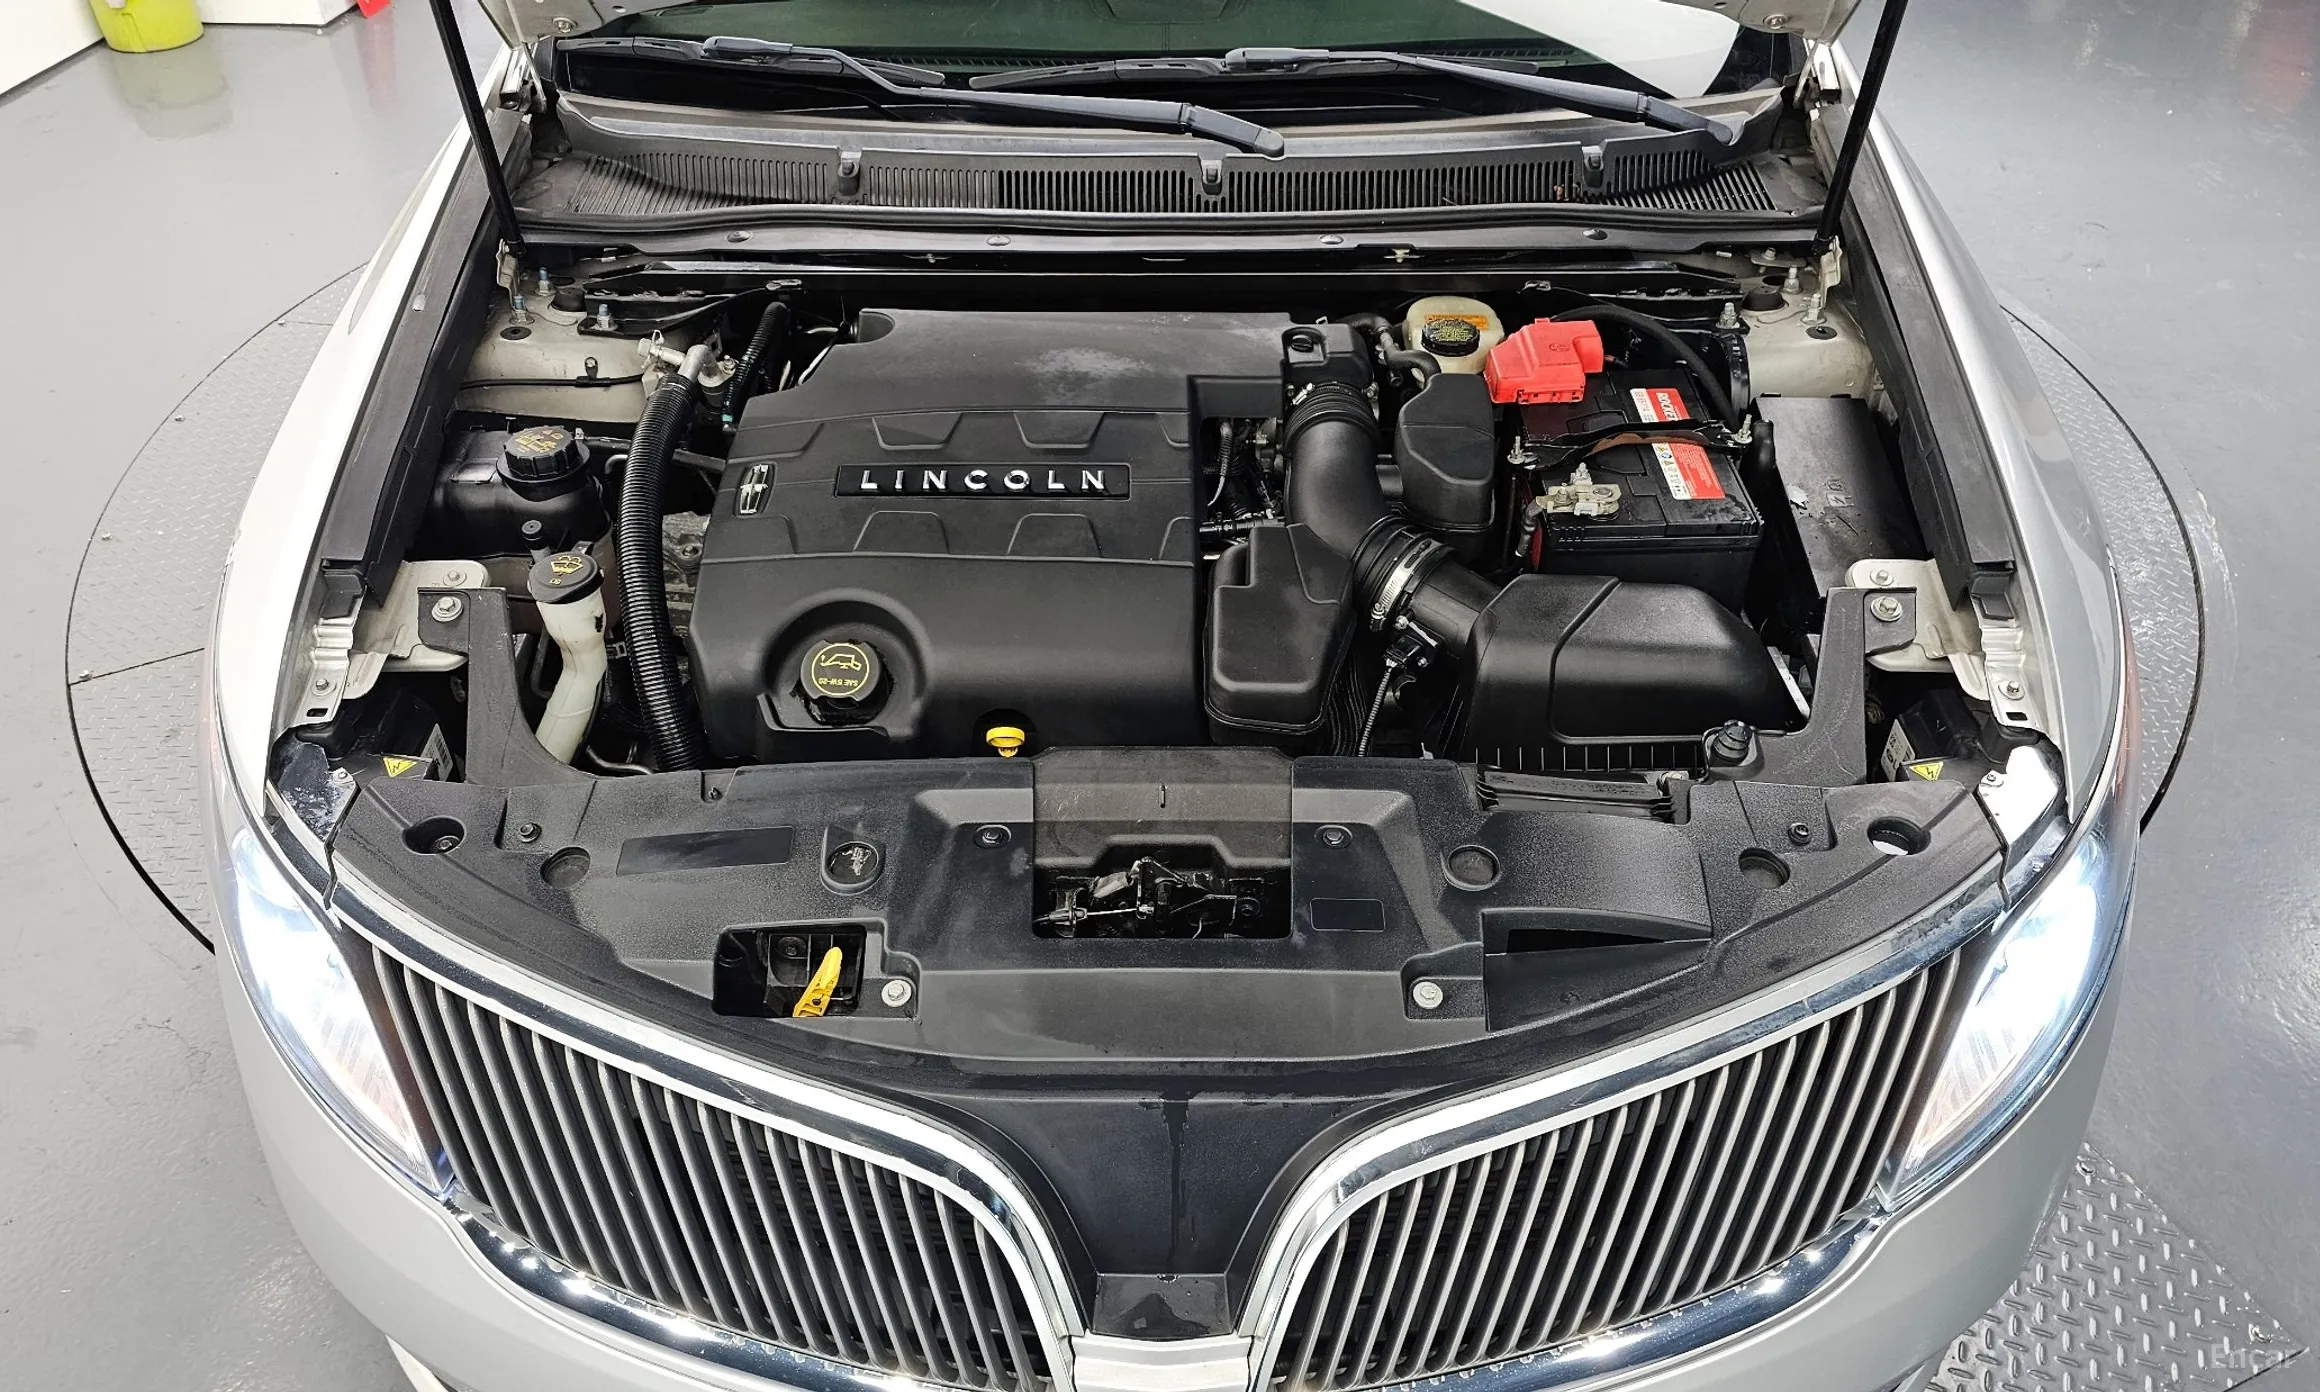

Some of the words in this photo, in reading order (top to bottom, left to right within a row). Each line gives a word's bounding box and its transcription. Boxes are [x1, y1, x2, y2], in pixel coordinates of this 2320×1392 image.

[1656, 392, 1679, 421] ROCKE
[860, 469, 1105, 491] LINCOLN
[844, 679, 859, 687] SAE
